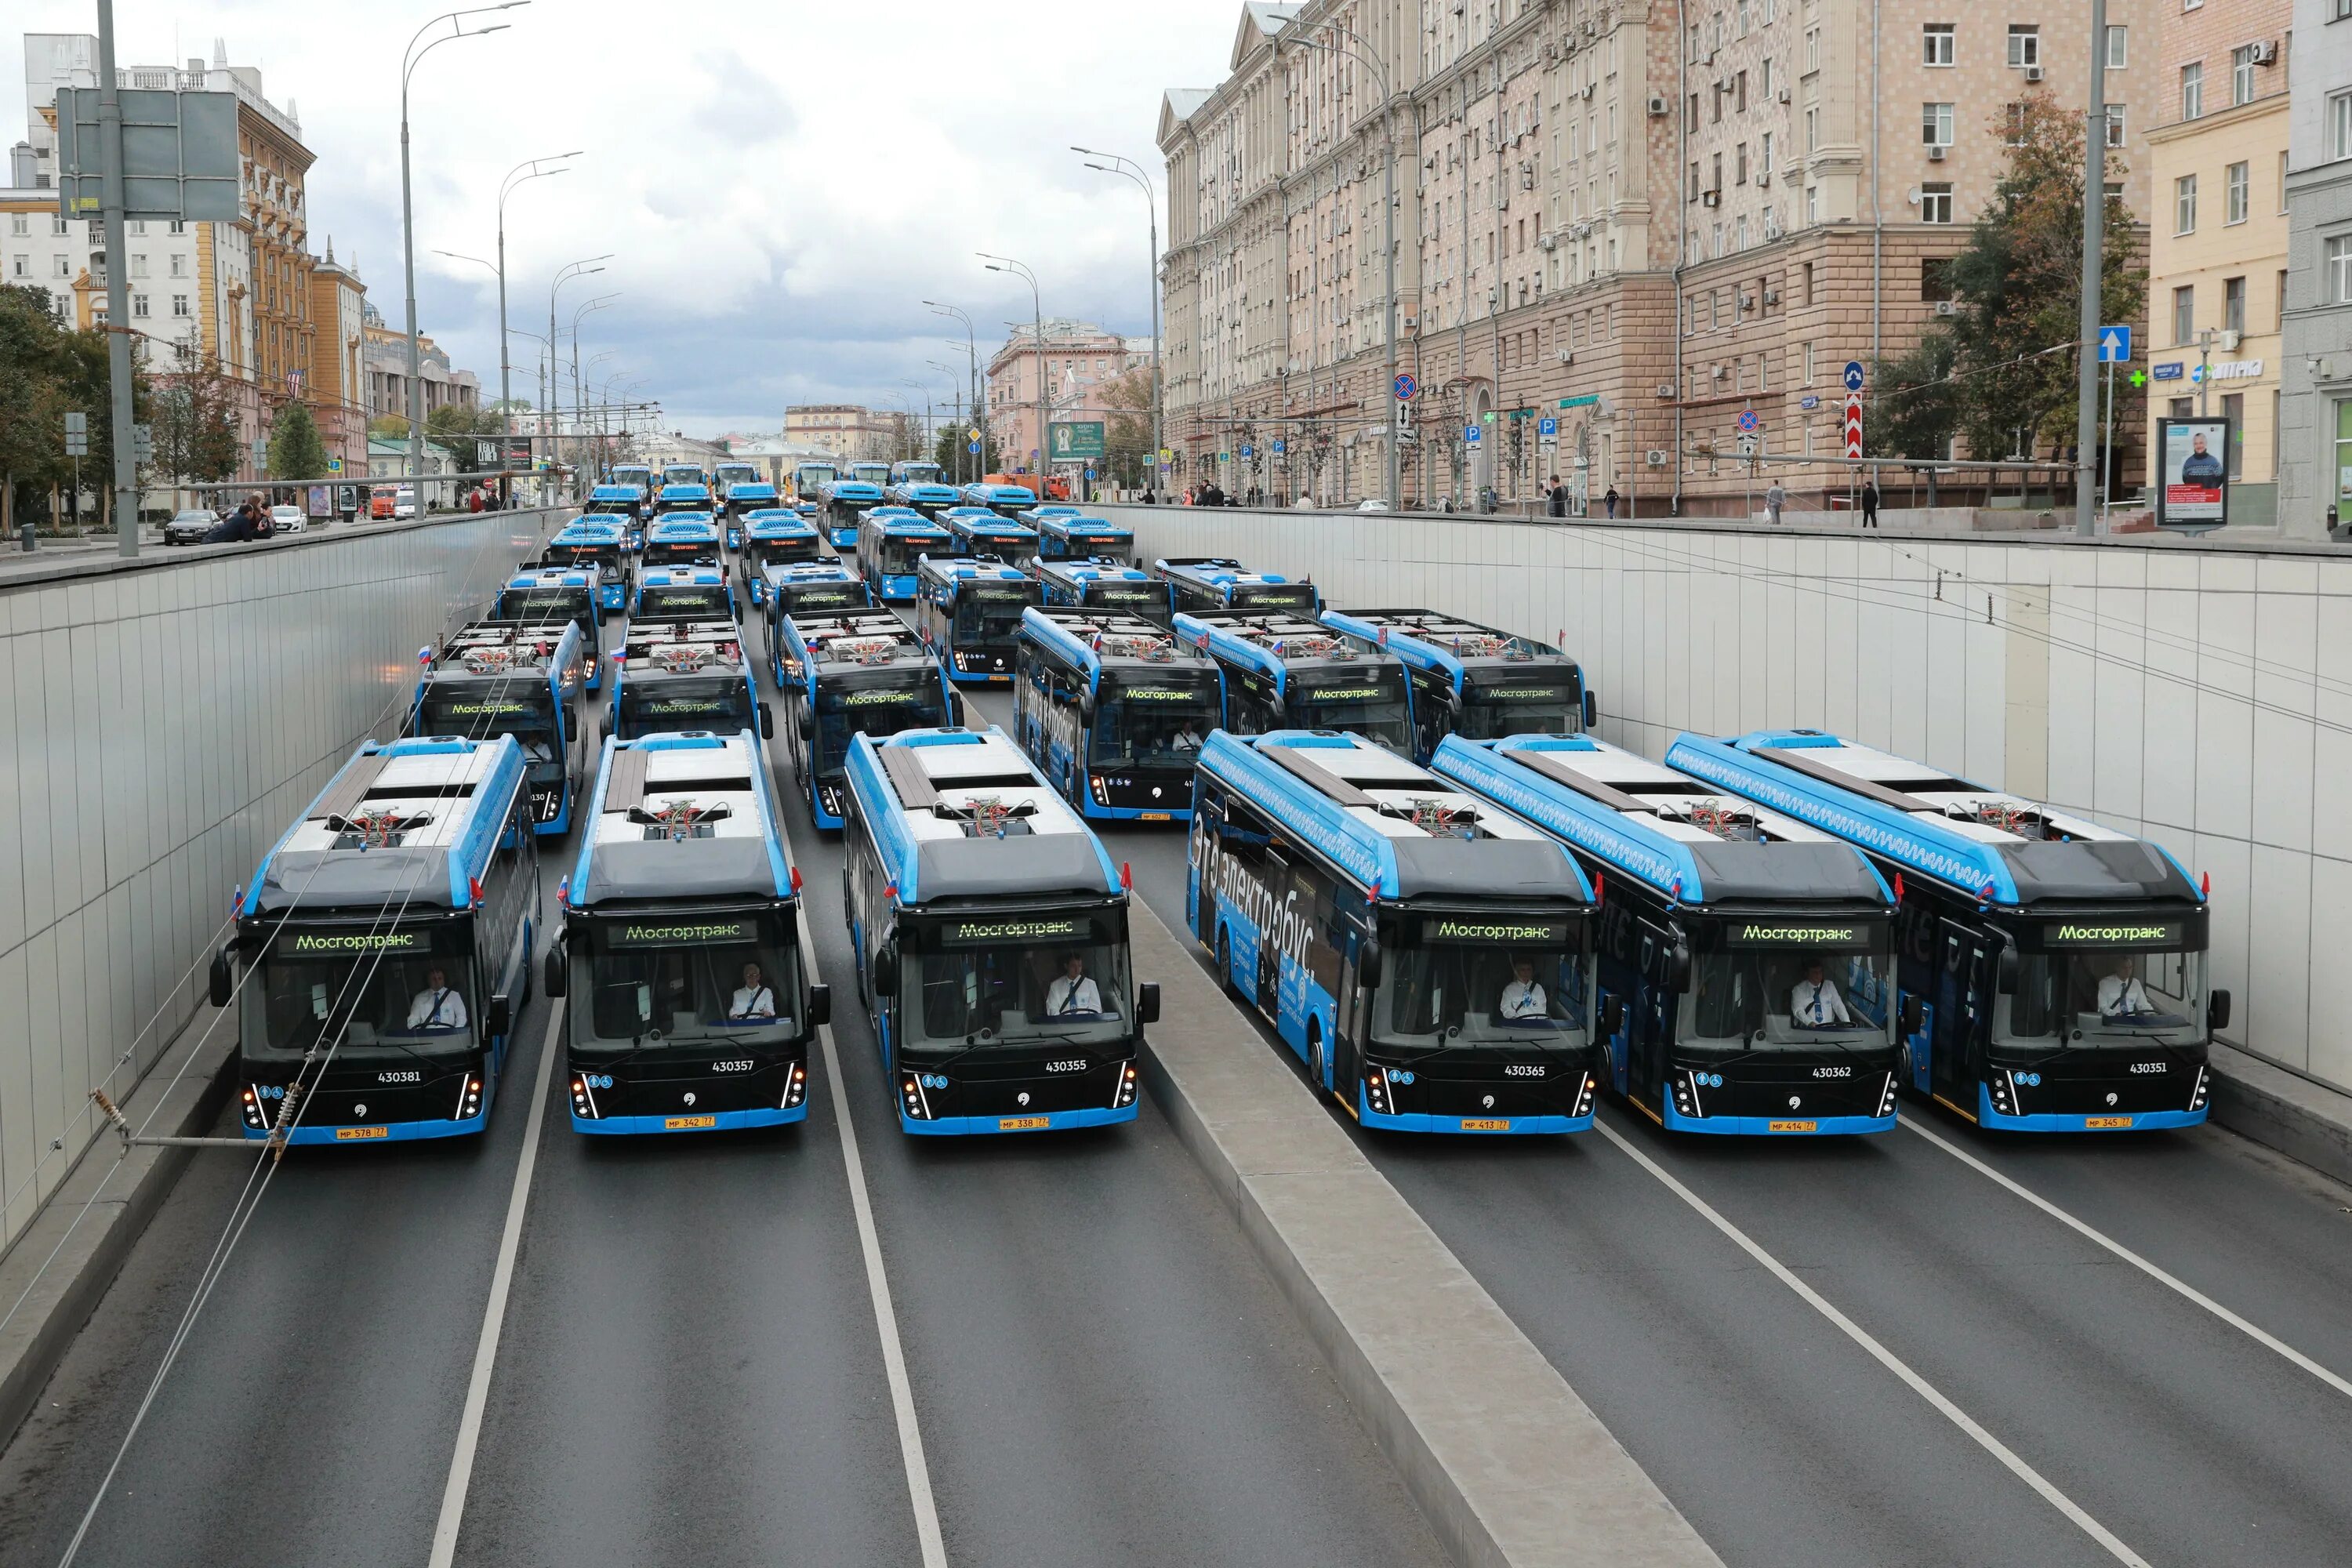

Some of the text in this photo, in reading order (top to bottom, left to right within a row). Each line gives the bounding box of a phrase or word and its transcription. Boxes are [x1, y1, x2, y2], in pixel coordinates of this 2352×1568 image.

[846, 693, 913, 706] Мосгортранс
[1127, 690, 1192, 701] Мосгортранс
[1313, 688, 1378, 699] Мосгортранс
[1490, 689, 1553, 699] Мосгортранс
[452, 704, 523, 715] Мосгортранс
[651, 702, 720, 713] Мосгортранс
[1192, 811, 1220, 890] Это
[627, 923, 740, 941] Мосгортранс
[959, 920, 1073, 938] Мосгортранс
[1438, 921, 1551, 940] Мосгортранс
[1742, 925, 1853, 942] Мосгортранс
[2058, 924, 2165, 941] Мосгортранс
[296, 931, 414, 949] Мосгортранс
[712, 1060, 754, 1073] 430357
[1046, 1059, 1087, 1073] 430355
[1504, 1065, 1545, 1076] 430365
[1813, 1066, 1851, 1078] 430362
[2129, 1062, 2167, 1074] 430351
[378, 1071, 421, 1083] 430381
[683, 1118, 699, 1127] 342
[1018, 1119, 1033, 1127] 338
[1786, 1122, 1802, 1131] 414
